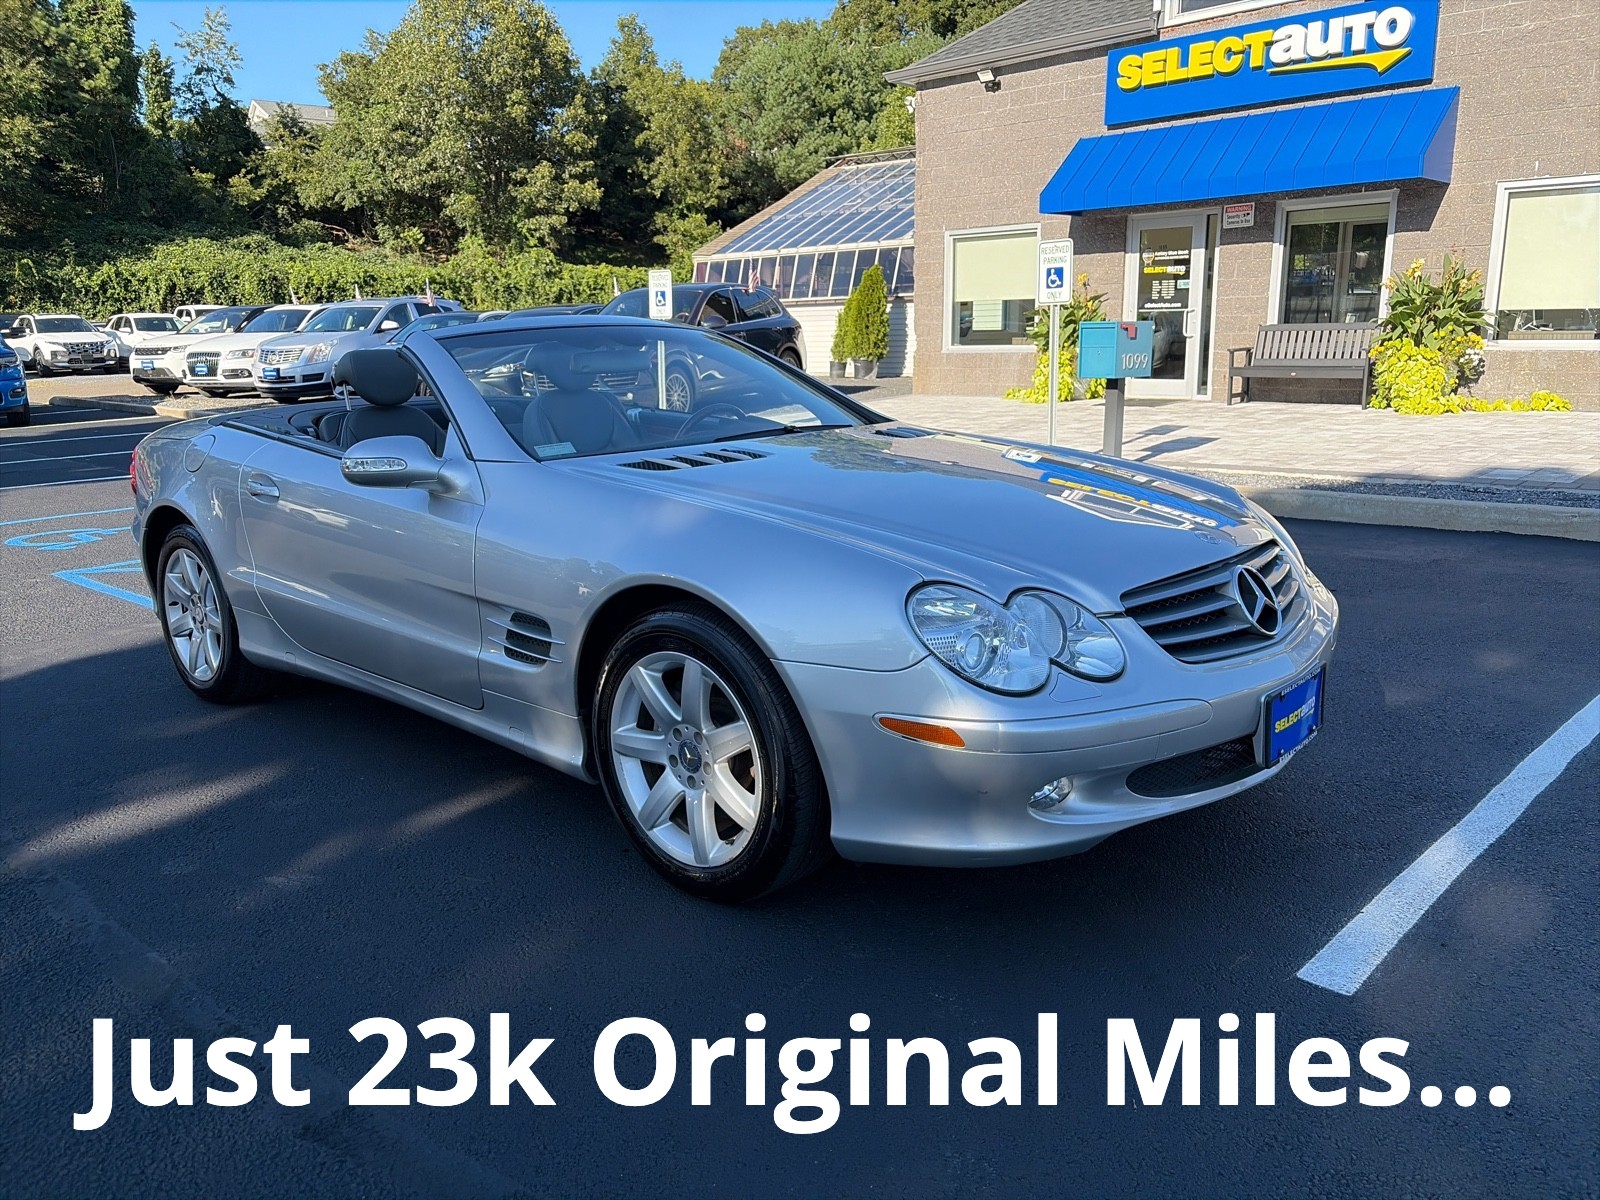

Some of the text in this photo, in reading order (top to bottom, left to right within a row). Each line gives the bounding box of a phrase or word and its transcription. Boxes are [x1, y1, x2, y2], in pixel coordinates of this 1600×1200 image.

[1226, 205, 1252, 213] WARNING
[1041, 244, 1069, 255] RESERVED
[1043, 255, 1067, 265] PARKING
[1047, 290, 1062, 300] ONLY
[1121, 352, 1148, 370] 1099
